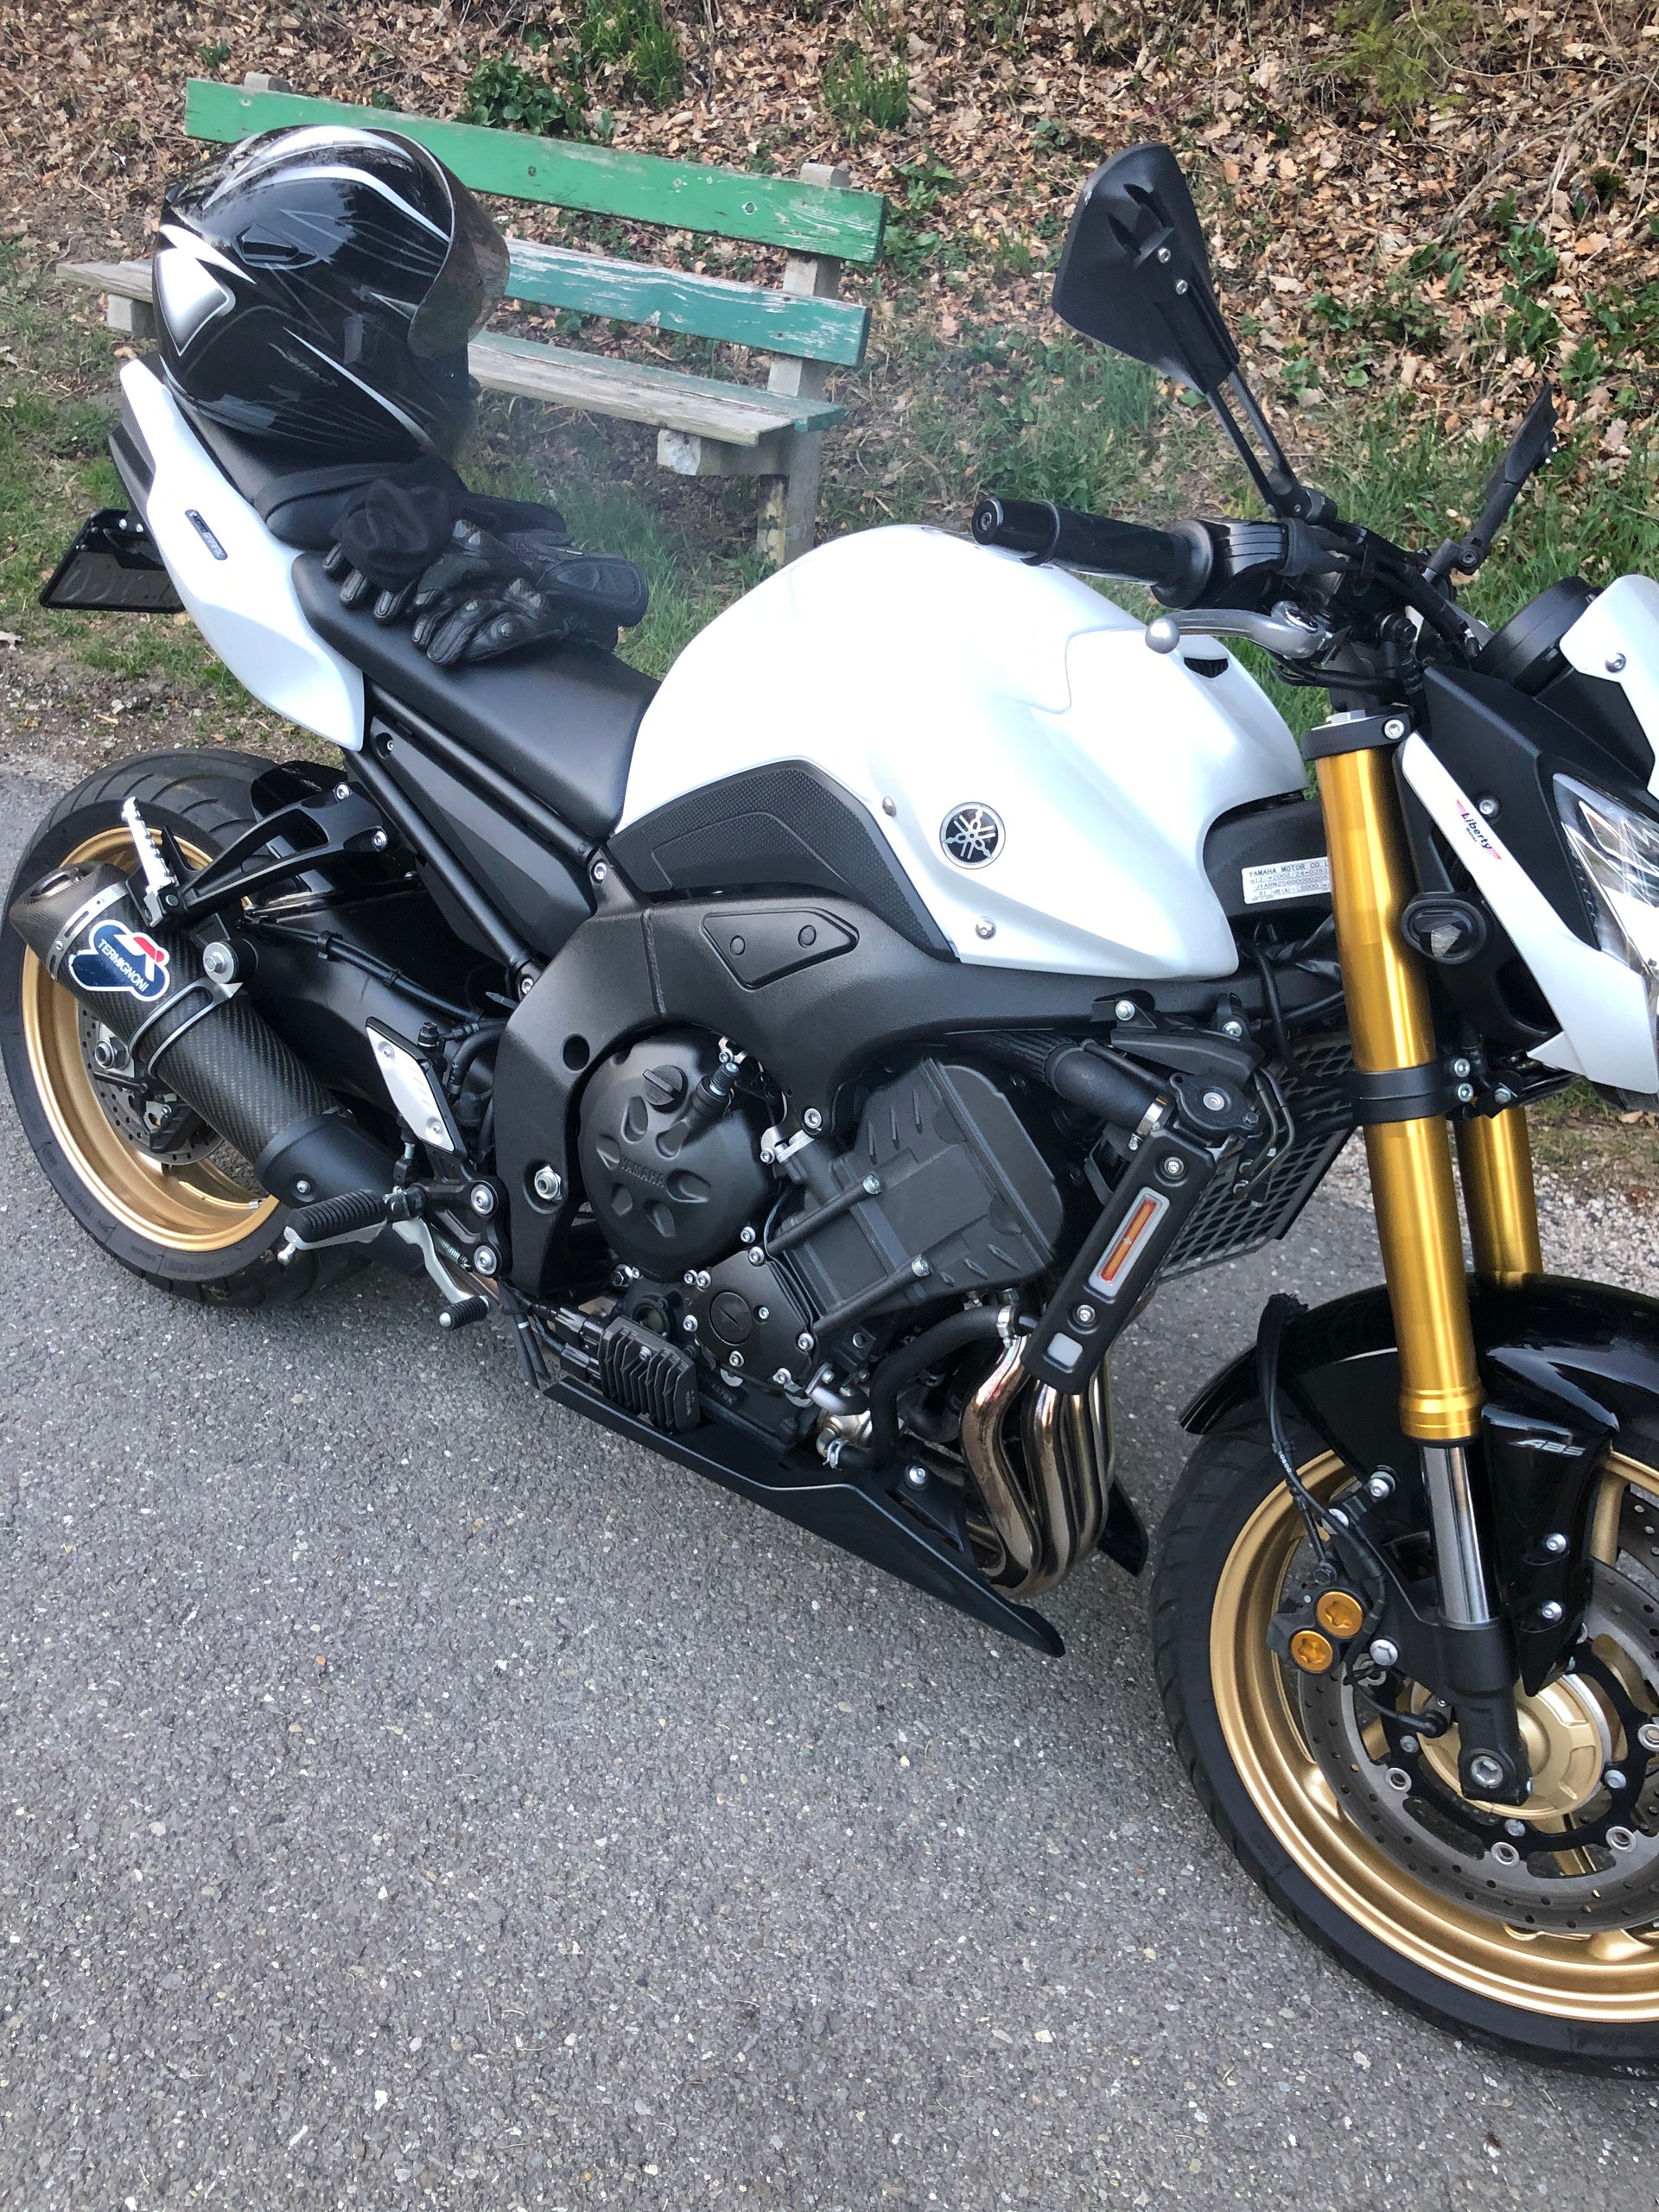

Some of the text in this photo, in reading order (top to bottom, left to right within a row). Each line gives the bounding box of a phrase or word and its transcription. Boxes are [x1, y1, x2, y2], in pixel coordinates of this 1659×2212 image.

[1461, 812, 1492, 849] Liberty
[1249, 868, 1276, 877] YAMAHA
[1281, 863, 1306, 873] MOTOR
[98, 938, 149, 992] TERMIGNONI
[621, 1156, 664, 1188] YAMAHA
[1516, 1439, 1586, 1457] ABS
